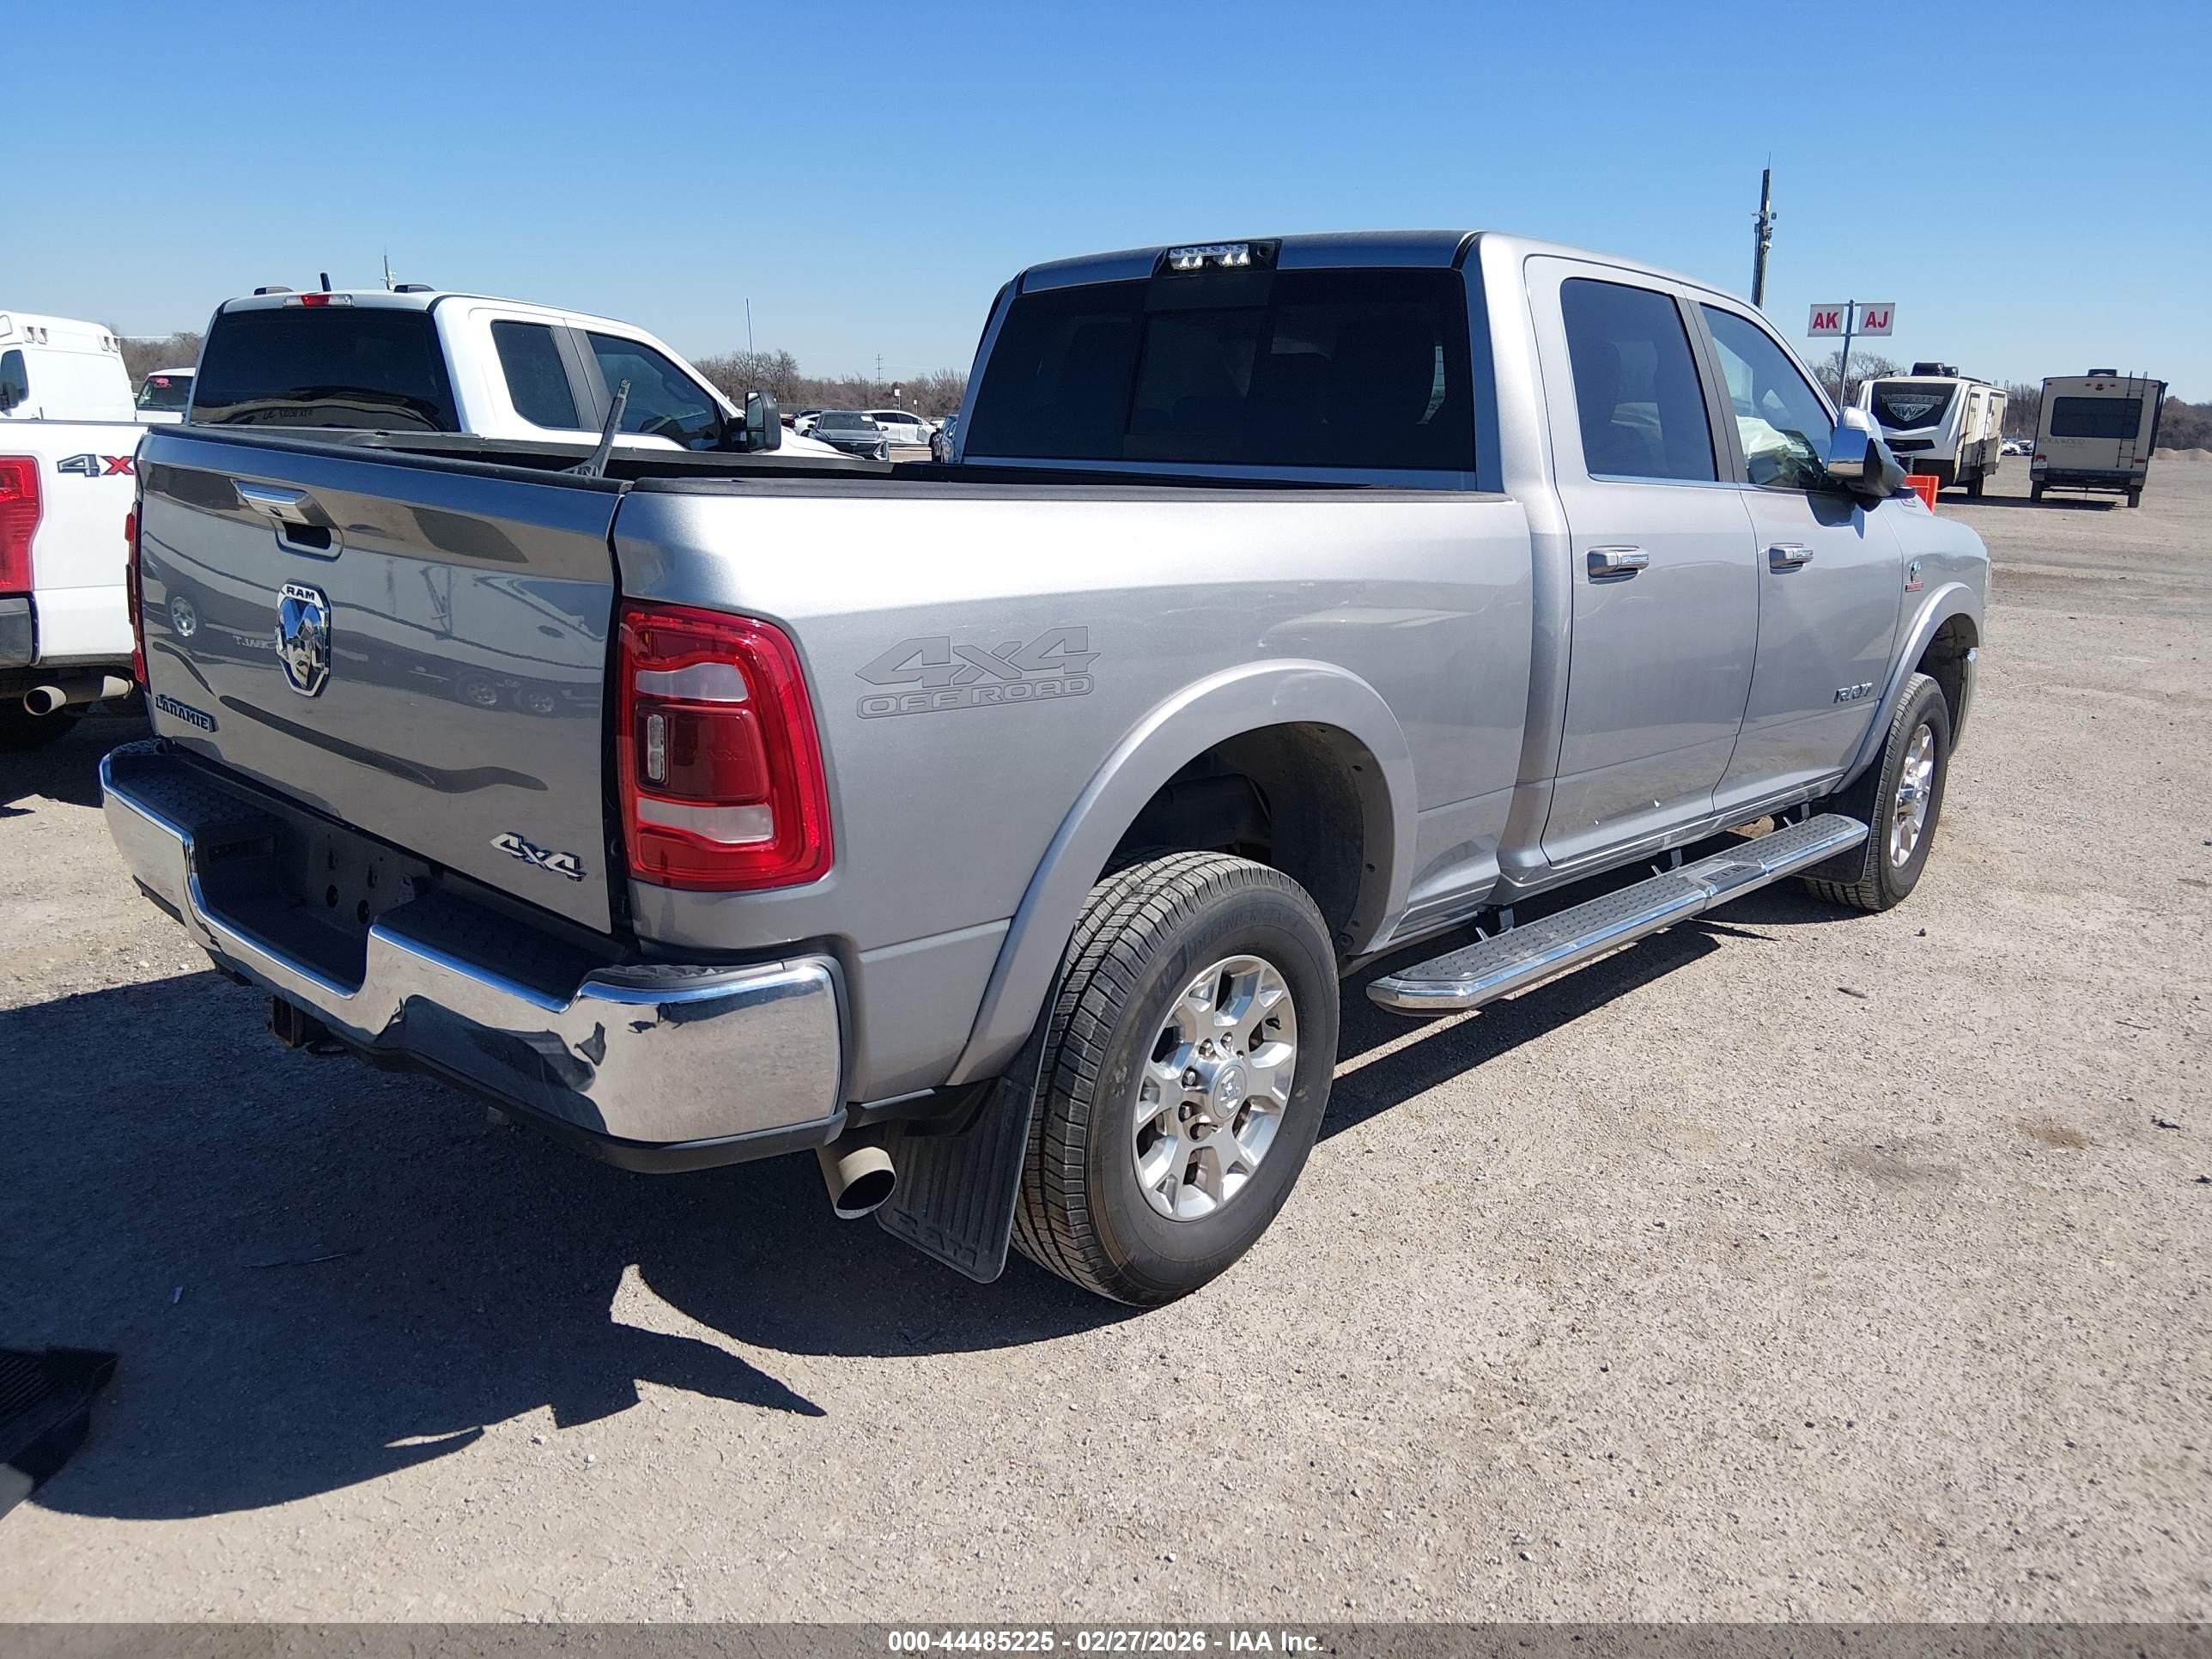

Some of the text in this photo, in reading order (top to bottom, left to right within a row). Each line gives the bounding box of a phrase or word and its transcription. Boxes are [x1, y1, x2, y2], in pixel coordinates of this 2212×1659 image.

[1812, 312, 1839, 329] AK
[1864, 311, 1889, 328] AJ
[286, 586, 315, 601] RAM
[861, 677, 1091, 715] OFF ROAD
[155, 696, 210, 731] LARAMIE
